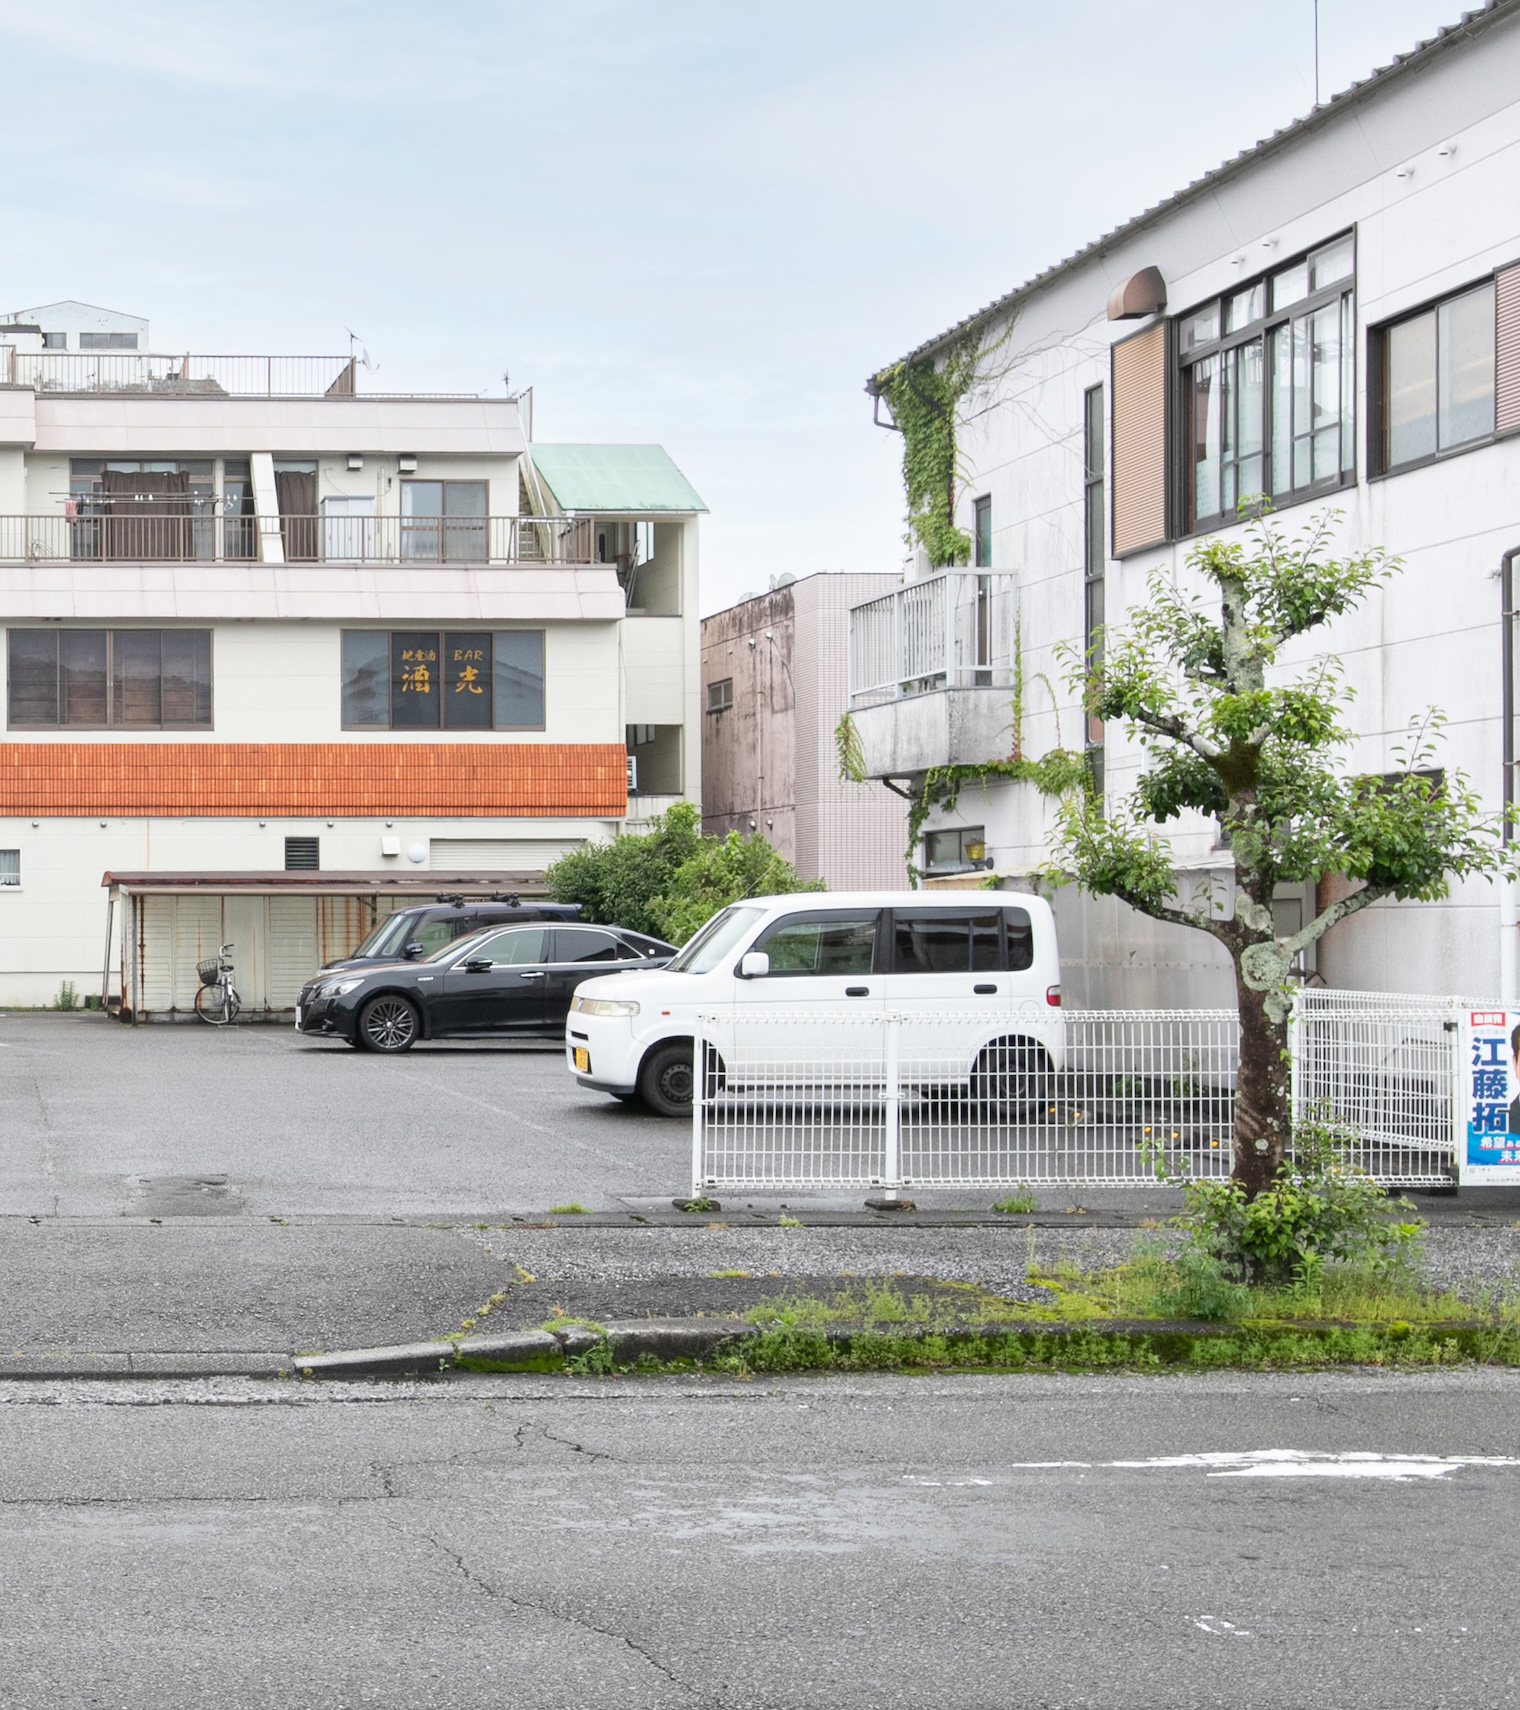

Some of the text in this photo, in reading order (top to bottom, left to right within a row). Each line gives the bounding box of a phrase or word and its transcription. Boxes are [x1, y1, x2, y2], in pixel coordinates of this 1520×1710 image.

[453, 649, 483, 661] BAR
[455, 664, 483, 694] 光
[1471, 1036, 1508, 1132] 江藤拓
